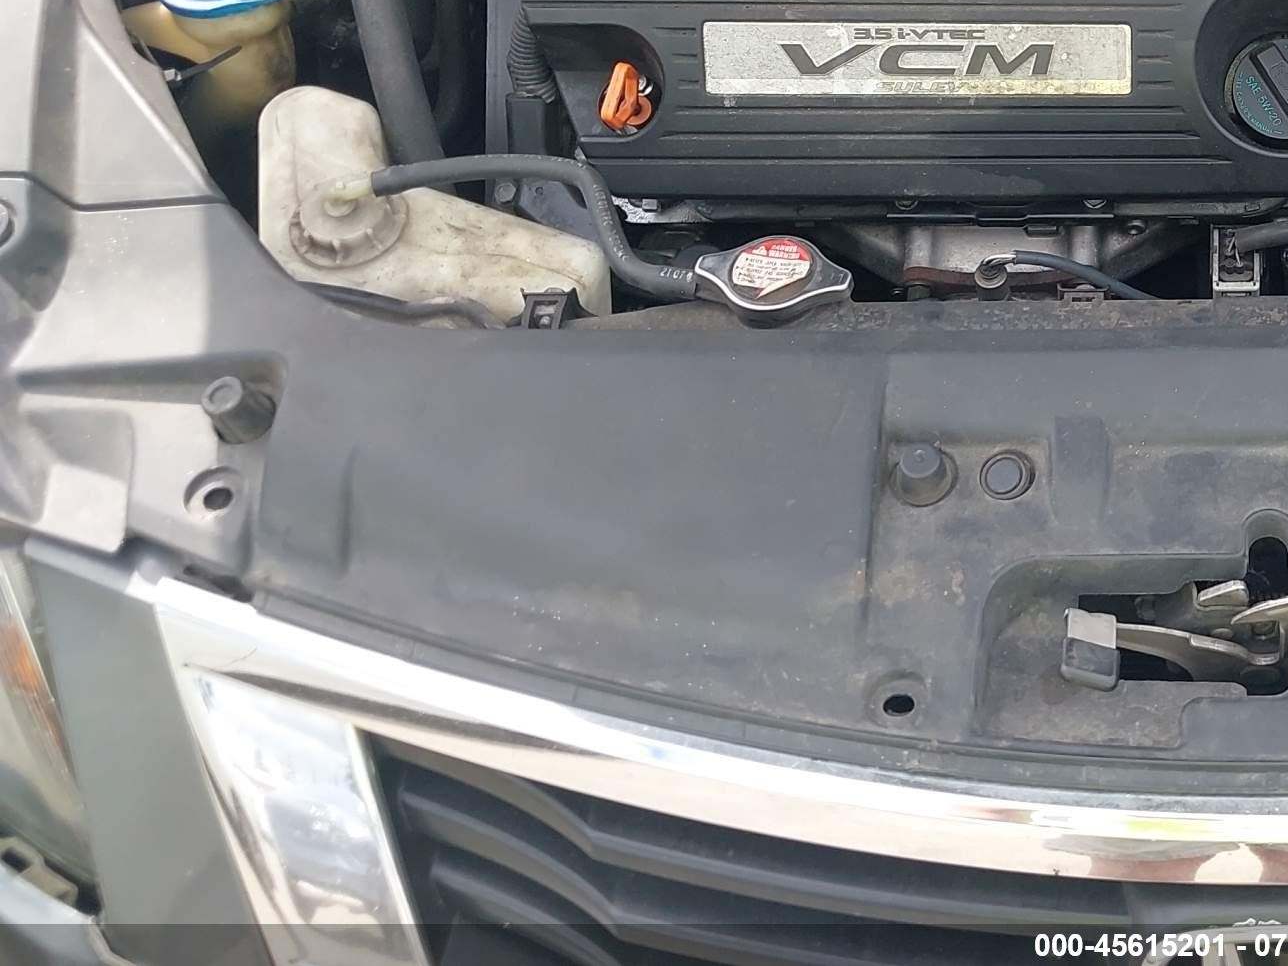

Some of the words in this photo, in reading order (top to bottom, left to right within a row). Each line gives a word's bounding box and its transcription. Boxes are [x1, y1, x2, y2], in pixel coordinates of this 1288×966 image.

[853, 27, 892, 40] 3.5
[898, 27, 985, 40] i-VTEC
[780, 43, 1056, 75] VCM
[1245, 76, 1262, 95] SAE
[1258, 95, 1282, 126] 5W-20
